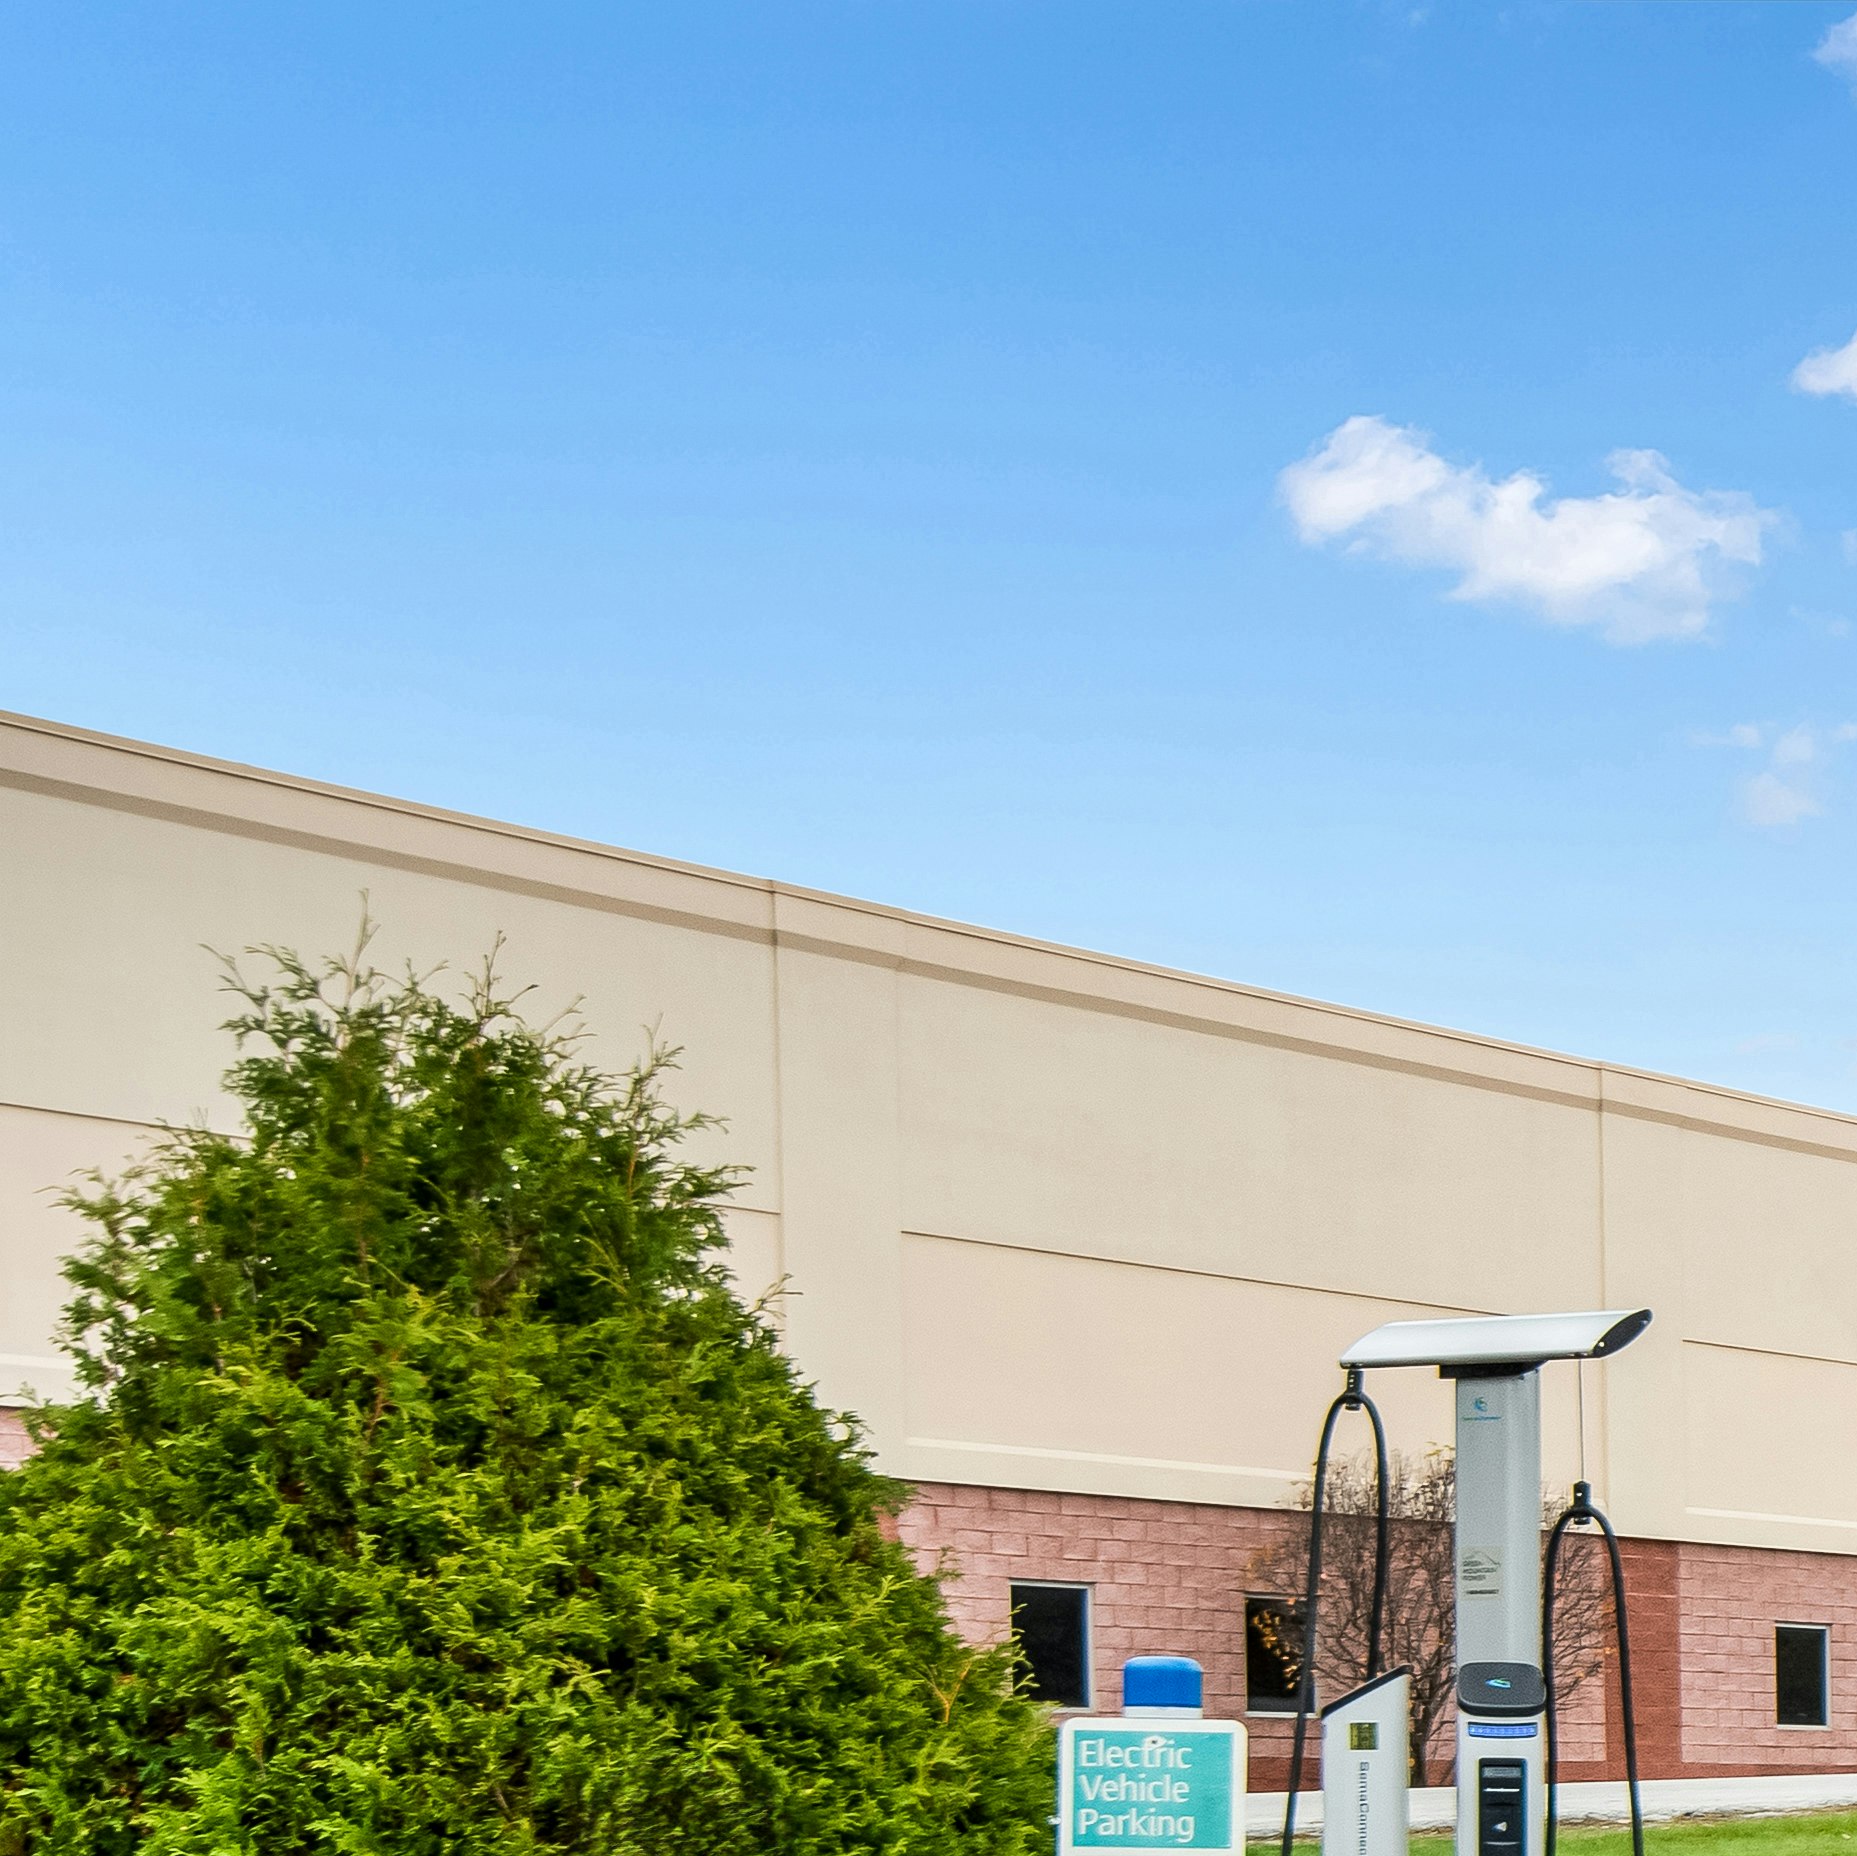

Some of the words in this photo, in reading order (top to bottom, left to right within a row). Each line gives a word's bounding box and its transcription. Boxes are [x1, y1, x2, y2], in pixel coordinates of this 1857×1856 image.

[1079, 1735, 1192, 1769] Electric
[1079, 1775, 1190, 1803] Vehicle
[1078, 1808, 1194, 1843] Parking
